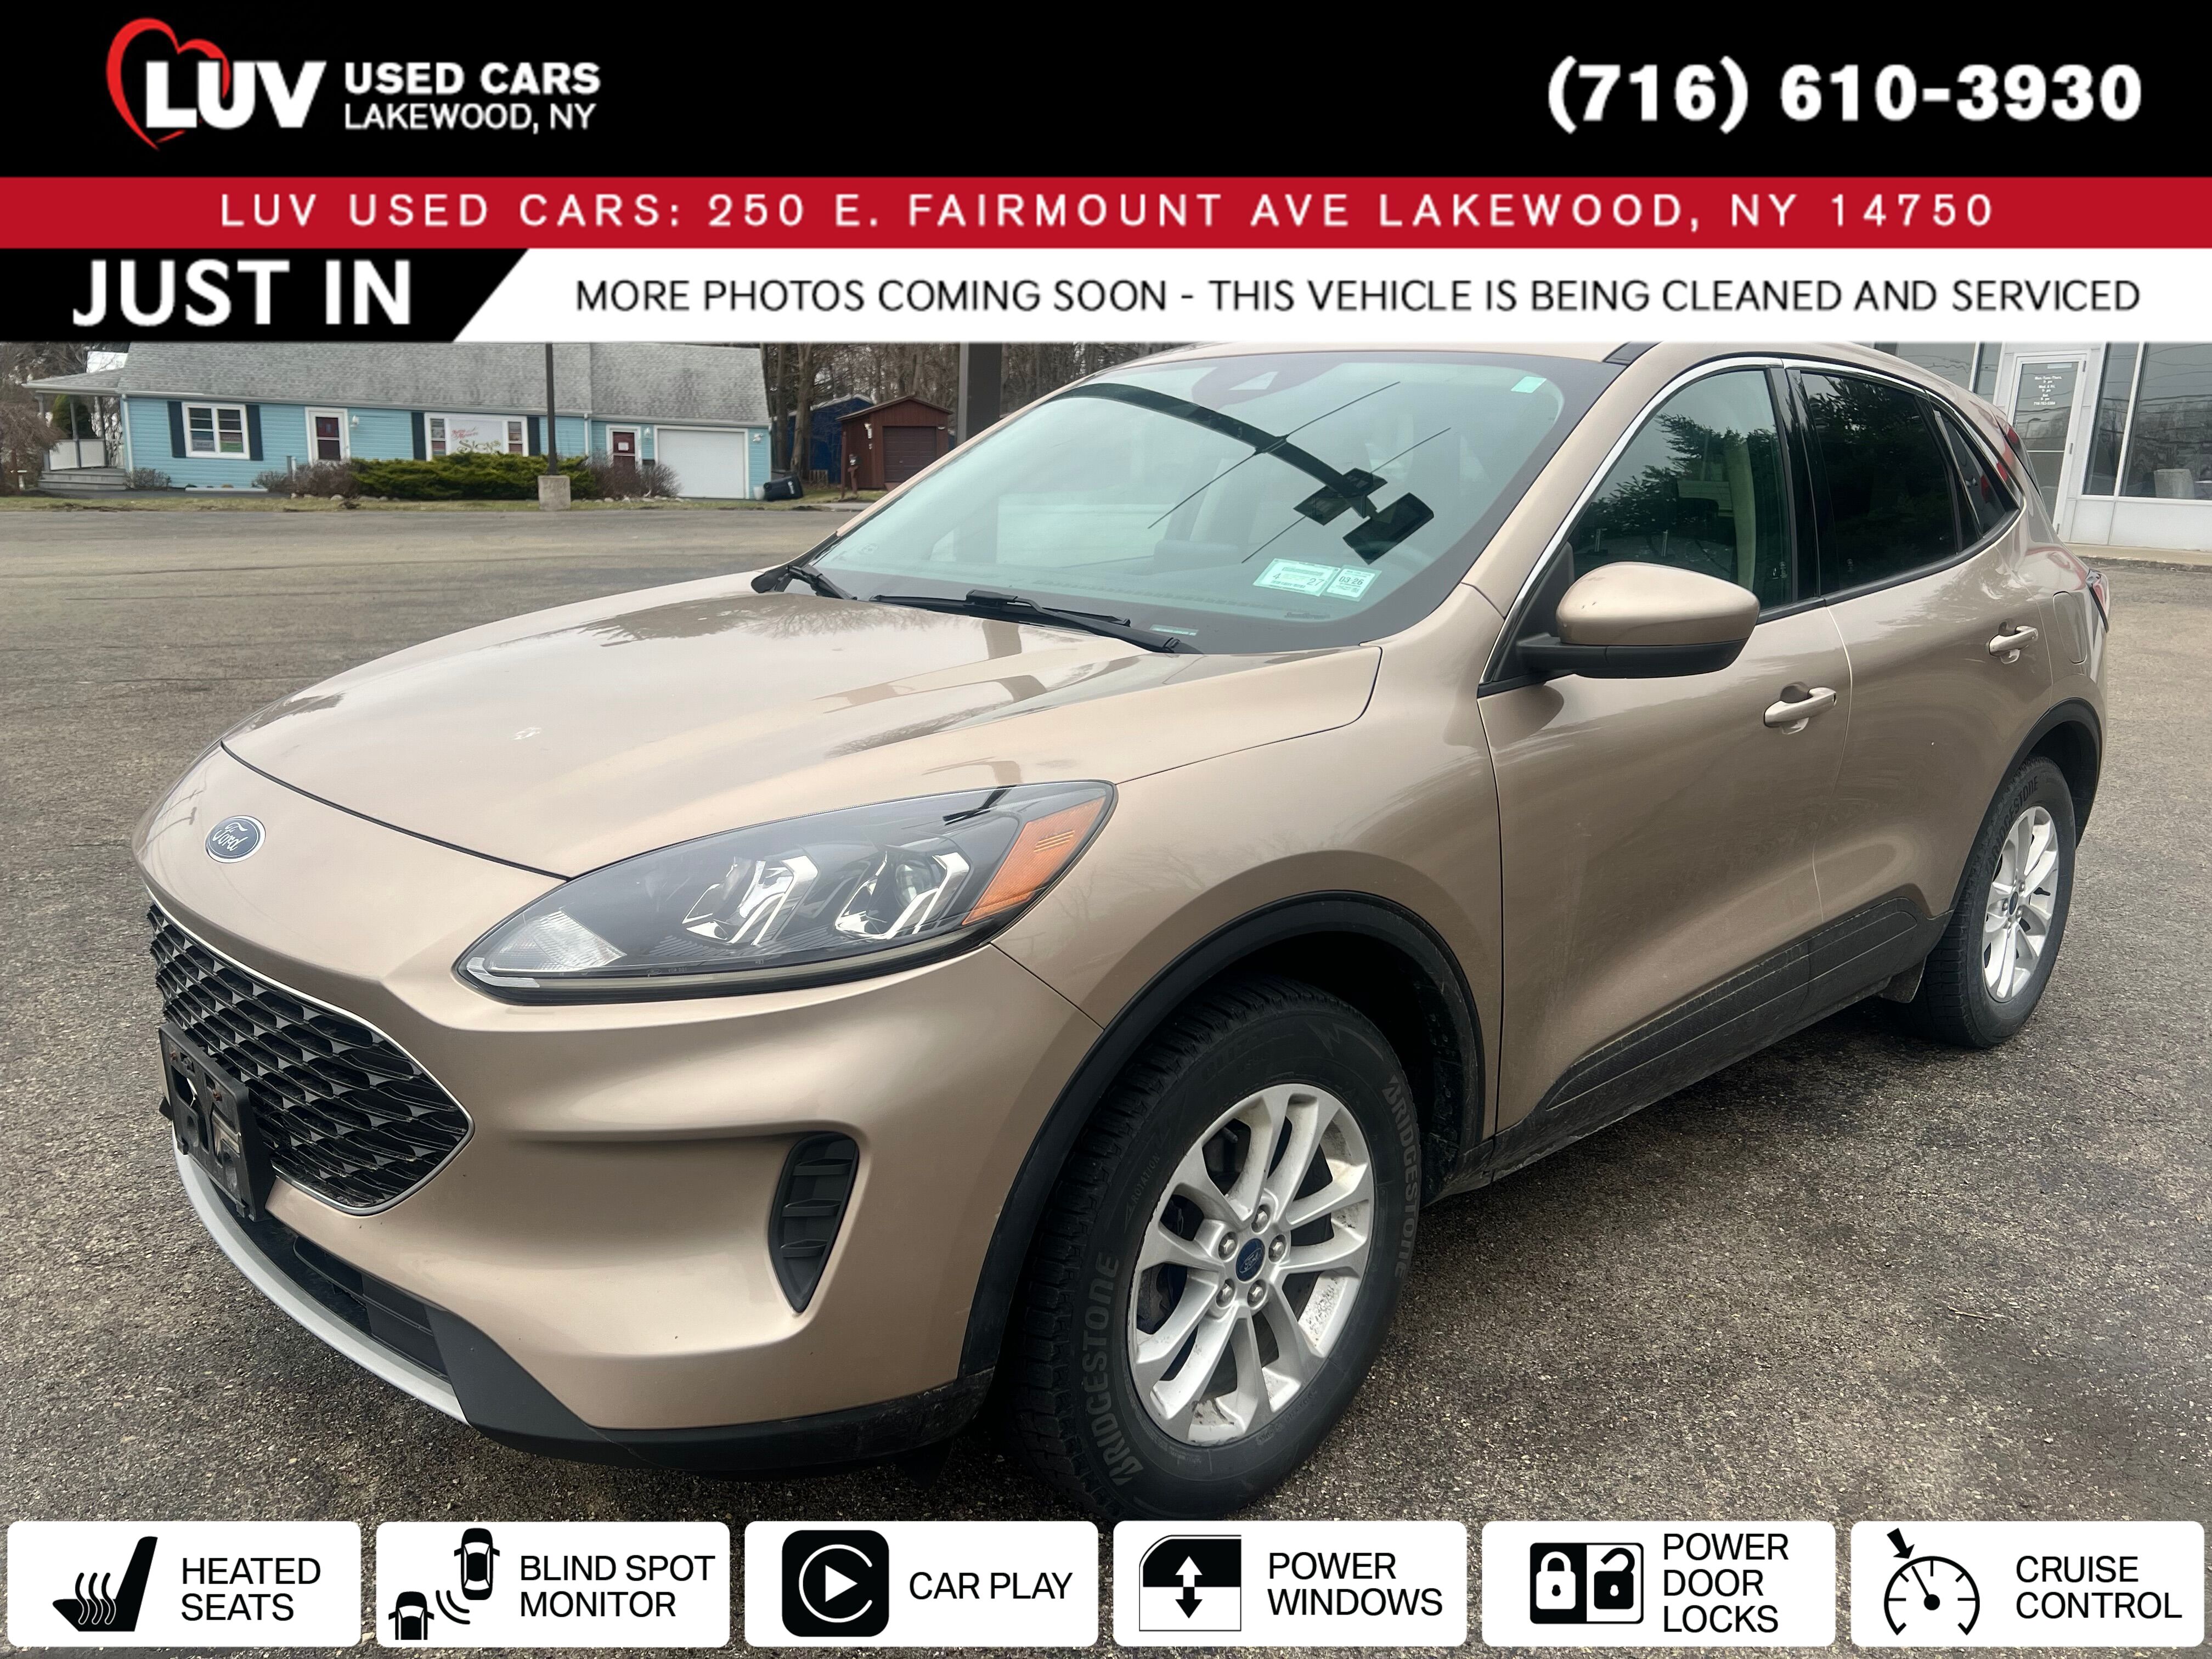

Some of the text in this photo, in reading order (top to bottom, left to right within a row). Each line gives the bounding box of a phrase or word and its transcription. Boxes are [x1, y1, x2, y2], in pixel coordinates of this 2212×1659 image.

[1306, 578, 1325, 586] 27
[1131, 1153, 1160, 1205] ROTATION
[1382, 1074, 1418, 1280] BRIDGESTONE
[1082, 1252, 1144, 1486] BRIDGESTONE
